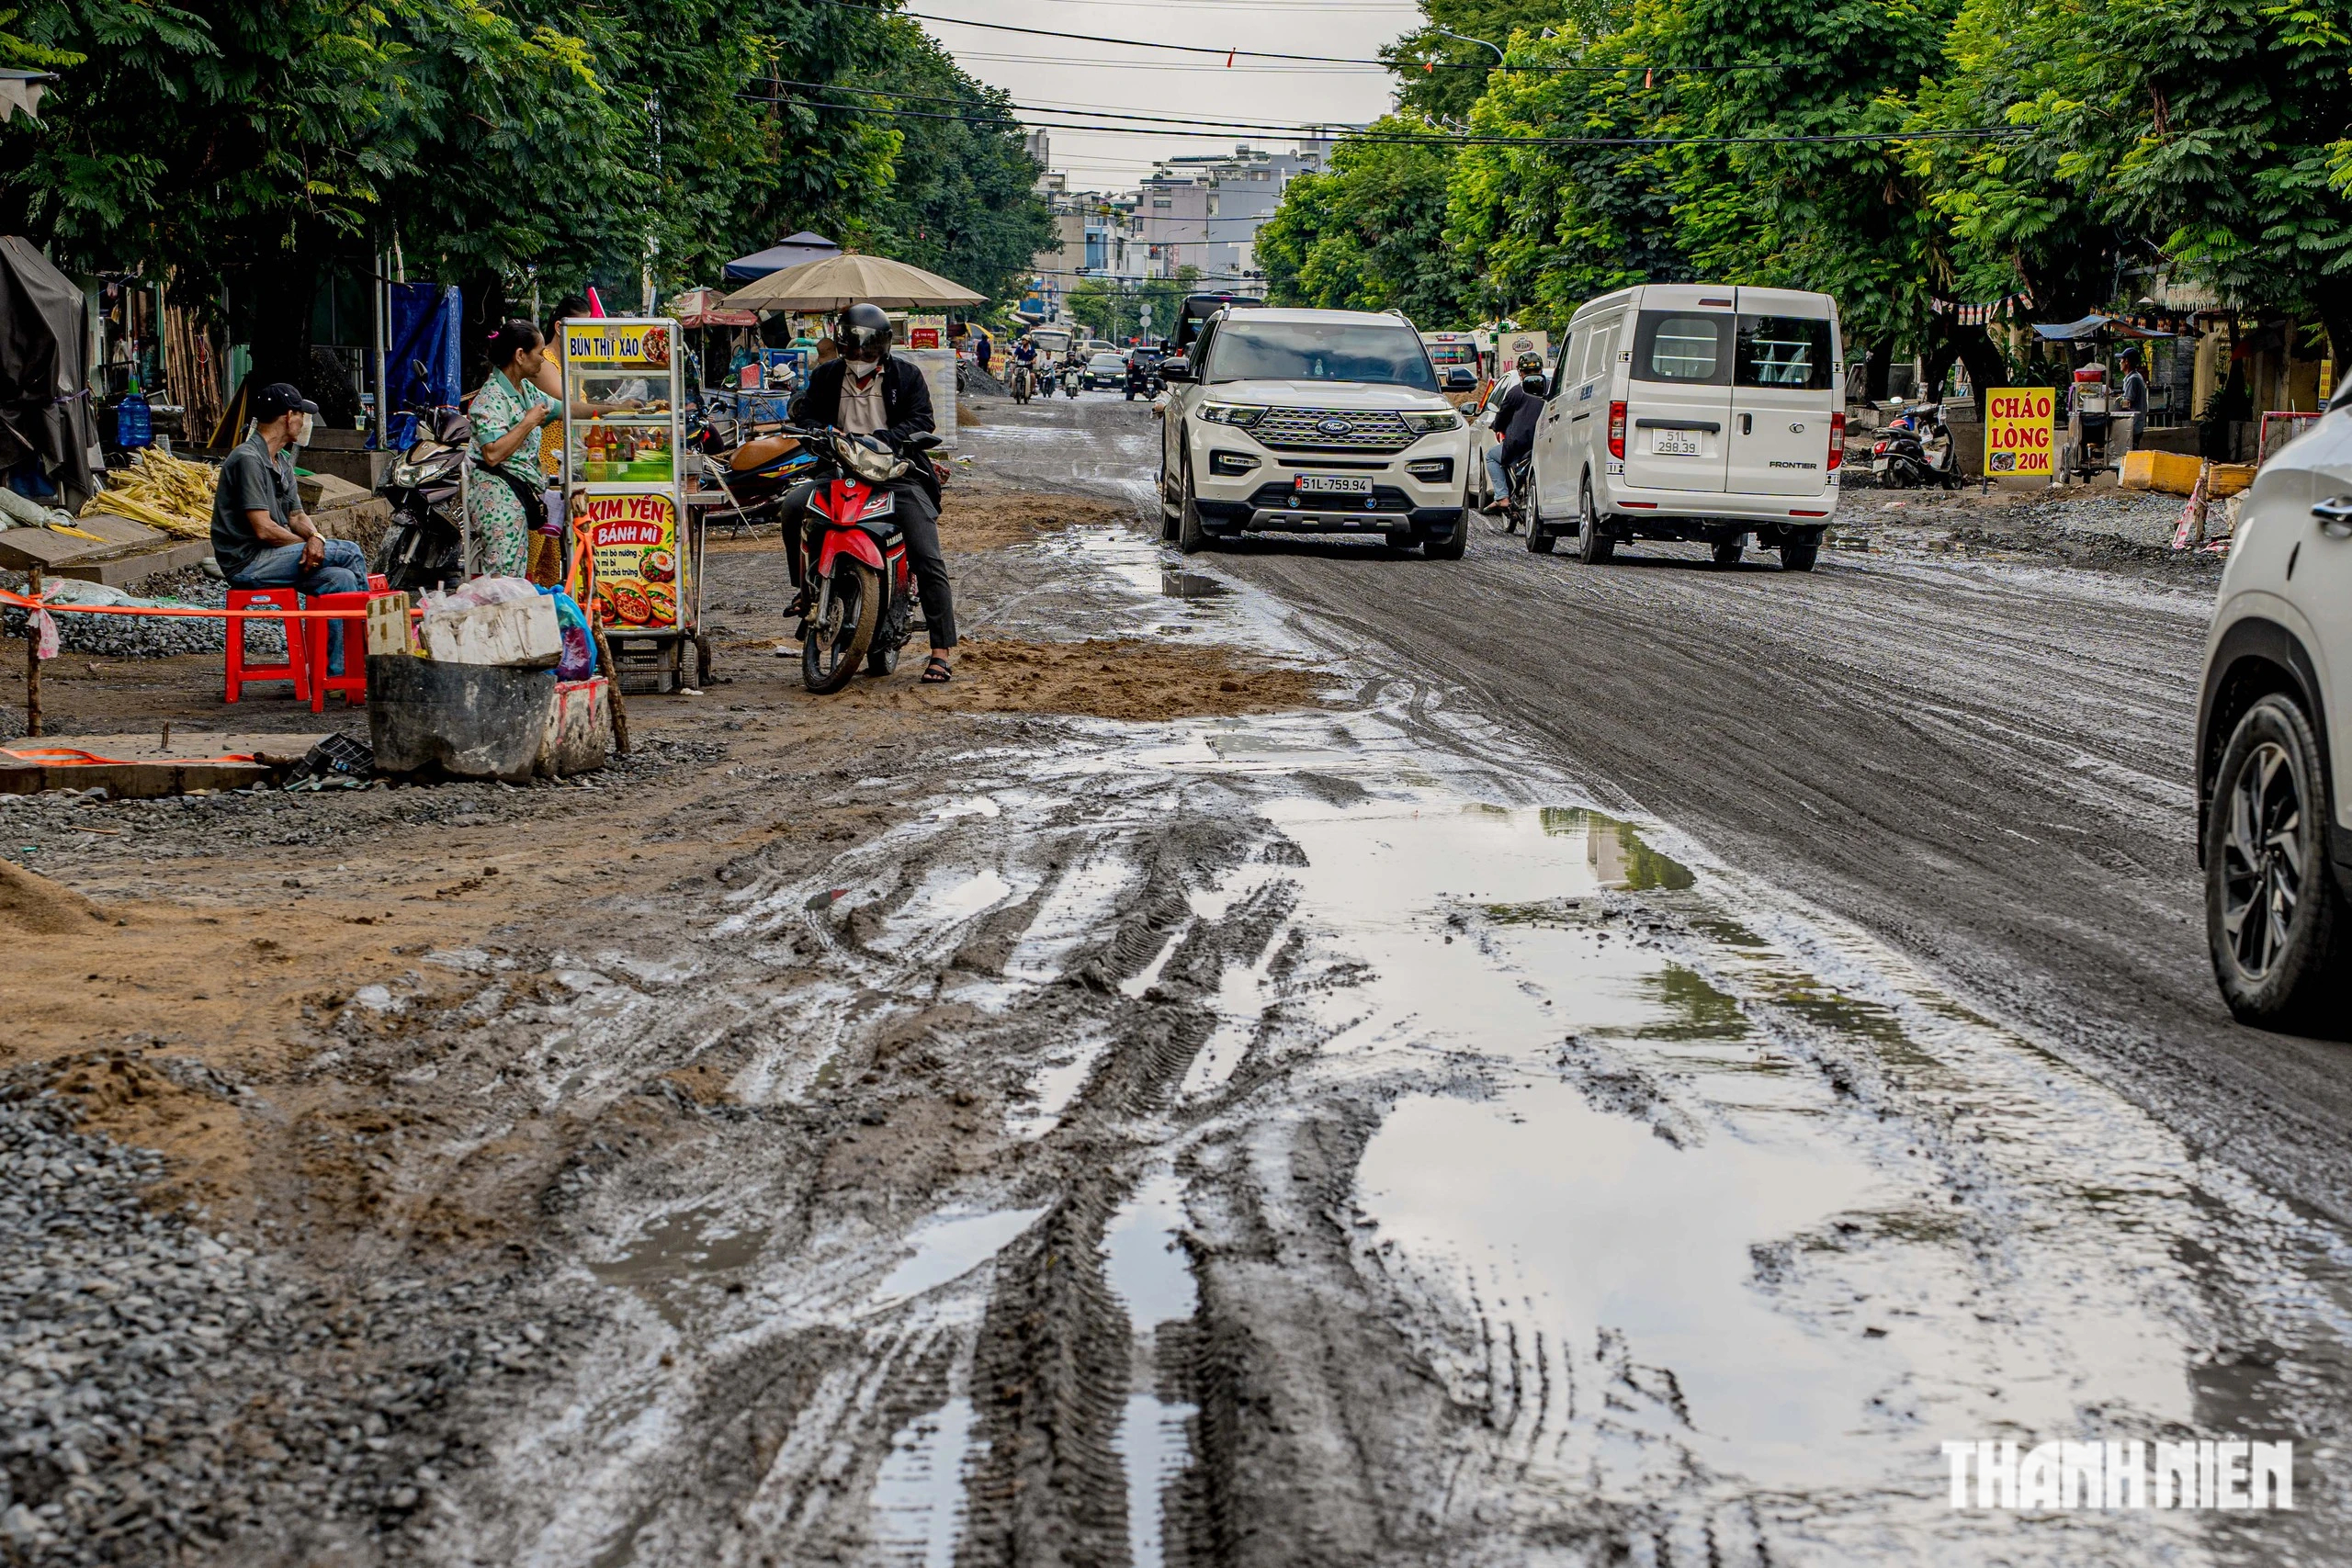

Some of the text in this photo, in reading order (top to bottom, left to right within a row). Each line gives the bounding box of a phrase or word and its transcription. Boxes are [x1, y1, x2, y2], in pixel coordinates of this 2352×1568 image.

[570, 333, 639, 360] BÚN THỊT XÀO
[1991, 391, 2051, 418] CHÁO
[1326, 423, 1345, 431] Ford
[1668, 432, 1688, 442] 51L
[1991, 422, 2049, 448] LÒNG
[1658, 442, 1696, 453] 298.39
[1770, 461, 1817, 469] FRONTIER
[2018, 453, 2049, 469] 20K
[1303, 479, 1366, 491] 51L-759.94
[588, 498, 624, 523] KIM
[598, 523, 658, 545] BÁNH MÌ
[886, 532, 903, 547] YAMAHA
[601, 548, 608, 557] mì
